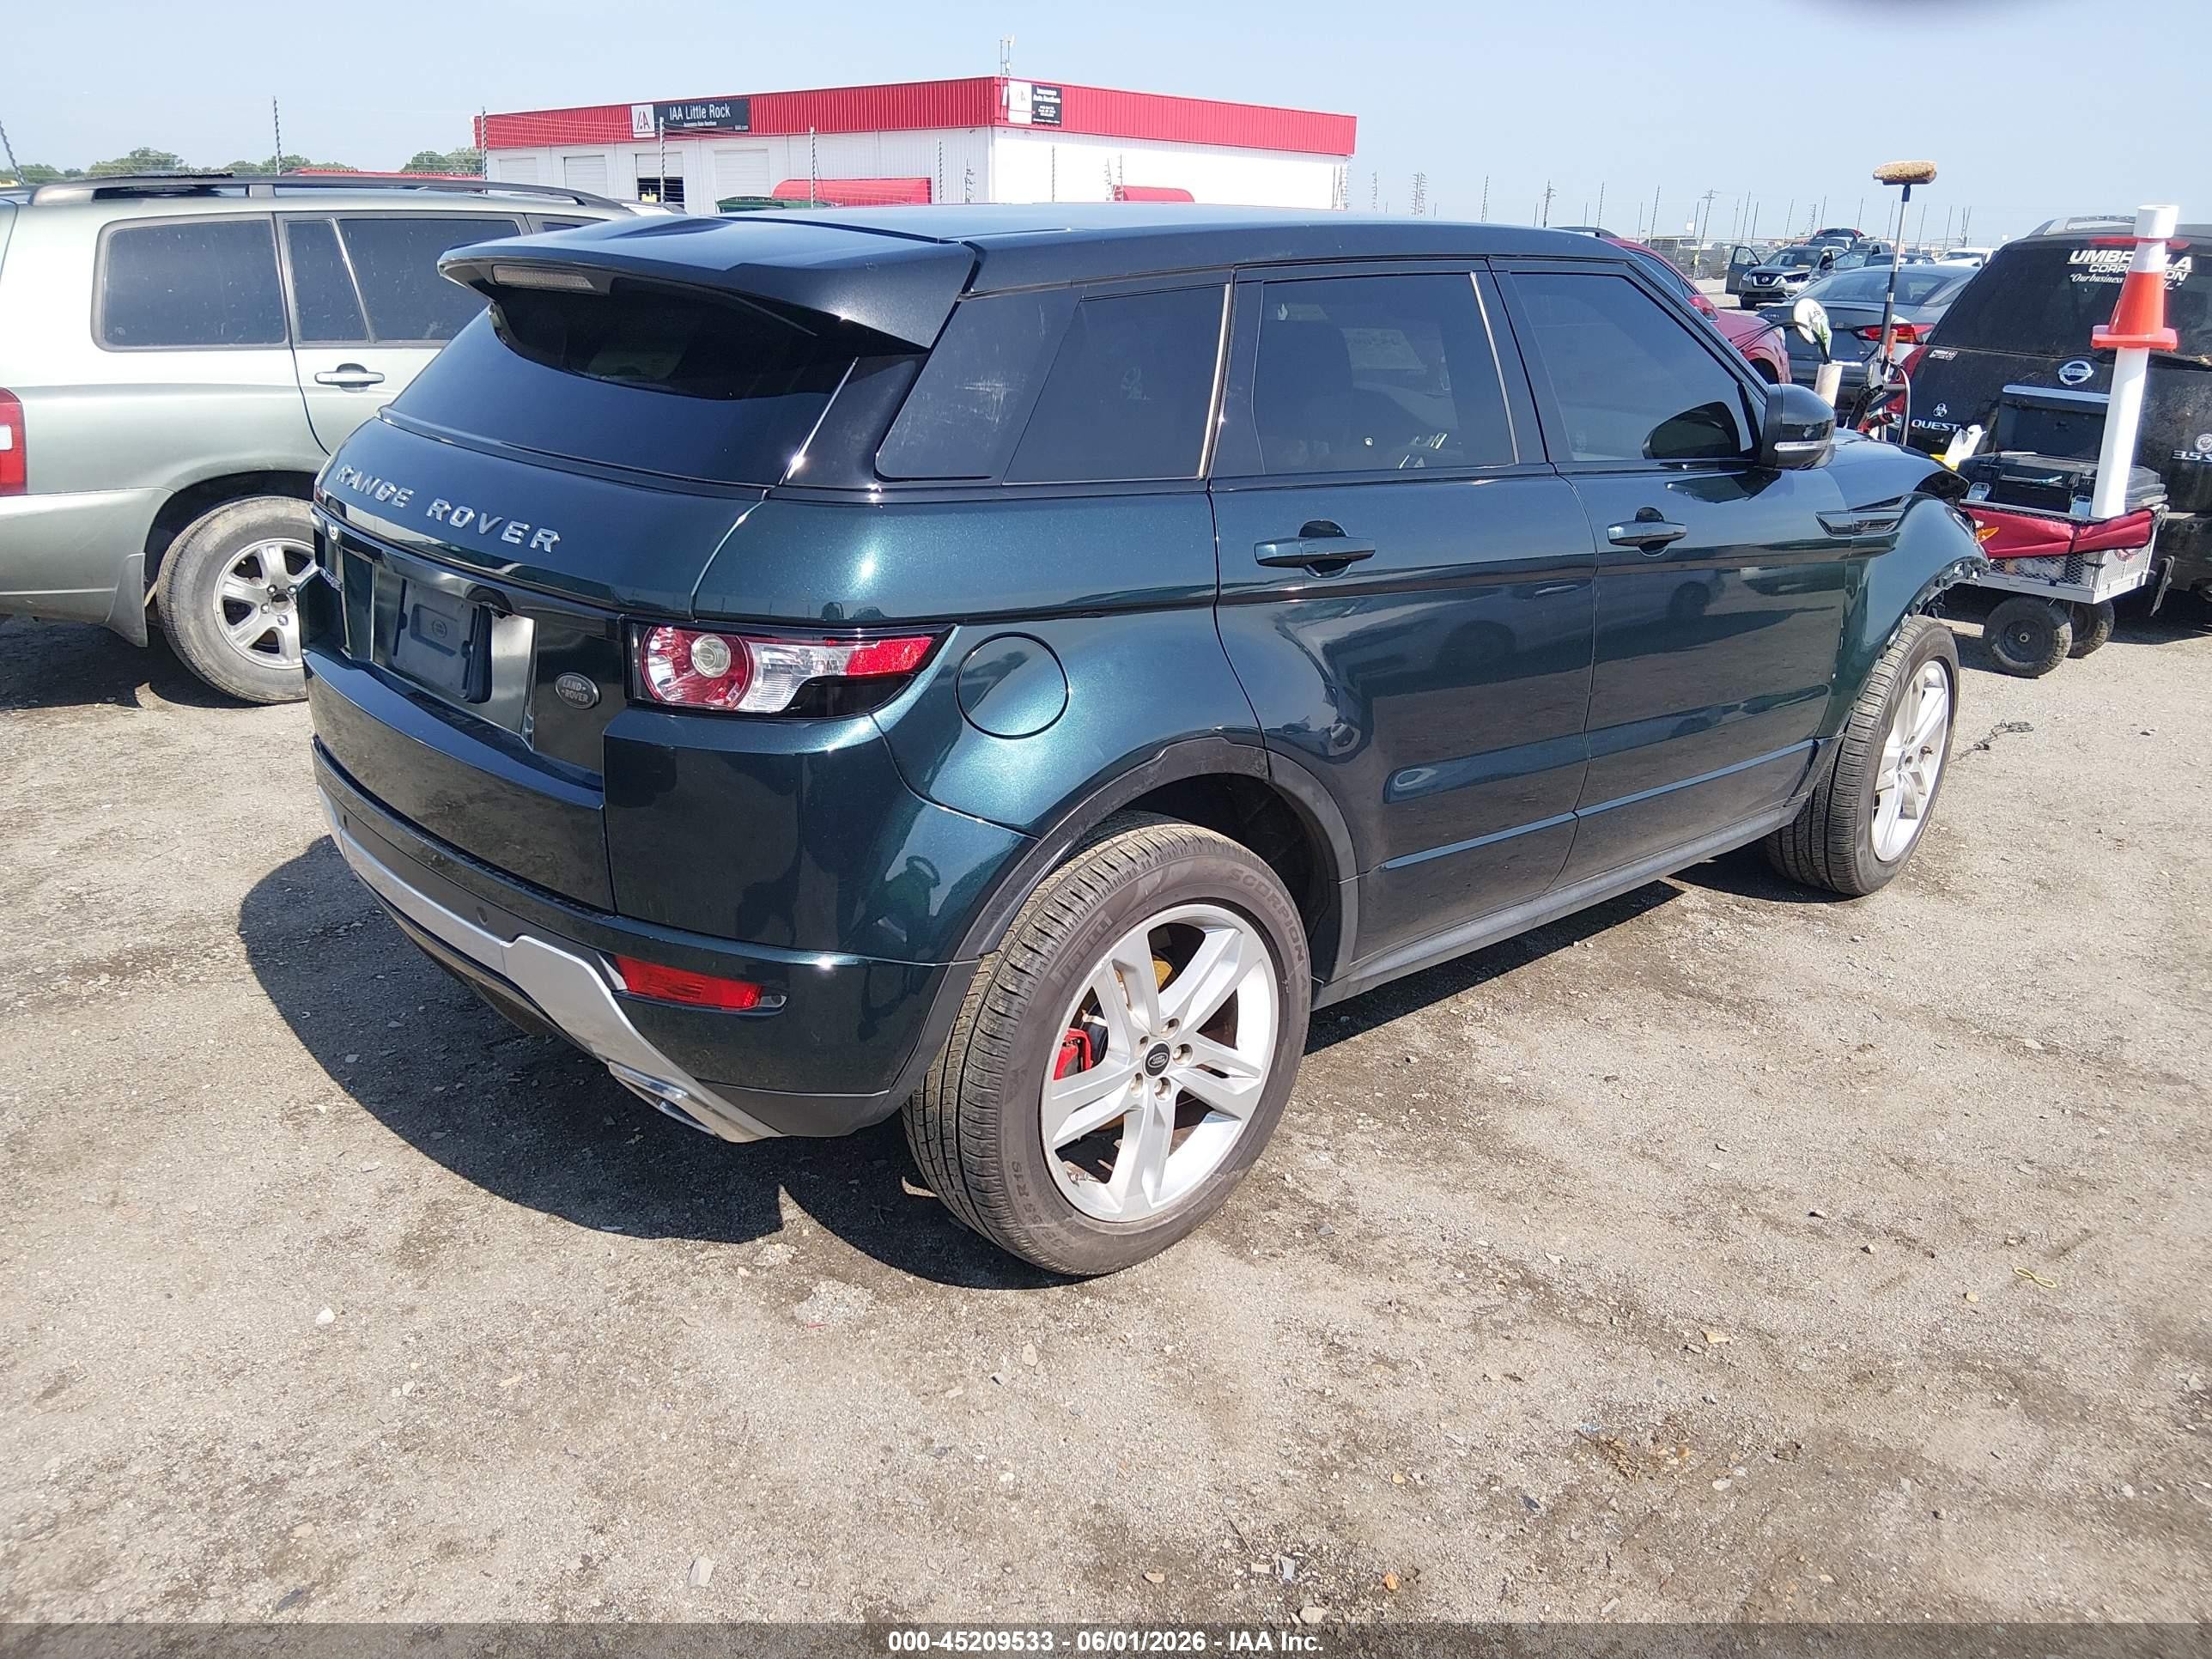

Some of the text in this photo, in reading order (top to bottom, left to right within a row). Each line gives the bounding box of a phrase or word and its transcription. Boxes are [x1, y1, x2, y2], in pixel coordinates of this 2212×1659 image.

[670, 102, 732, 121] IAA Little Rock
[2069, 250, 2192, 270] UMBRLA
[1911, 419, 1961, 432] QUEST
[336, 464, 561, 554] RANGE ROVER
[562, 678, 582, 691] LAND
[564, 689, 589, 703] ROVER
